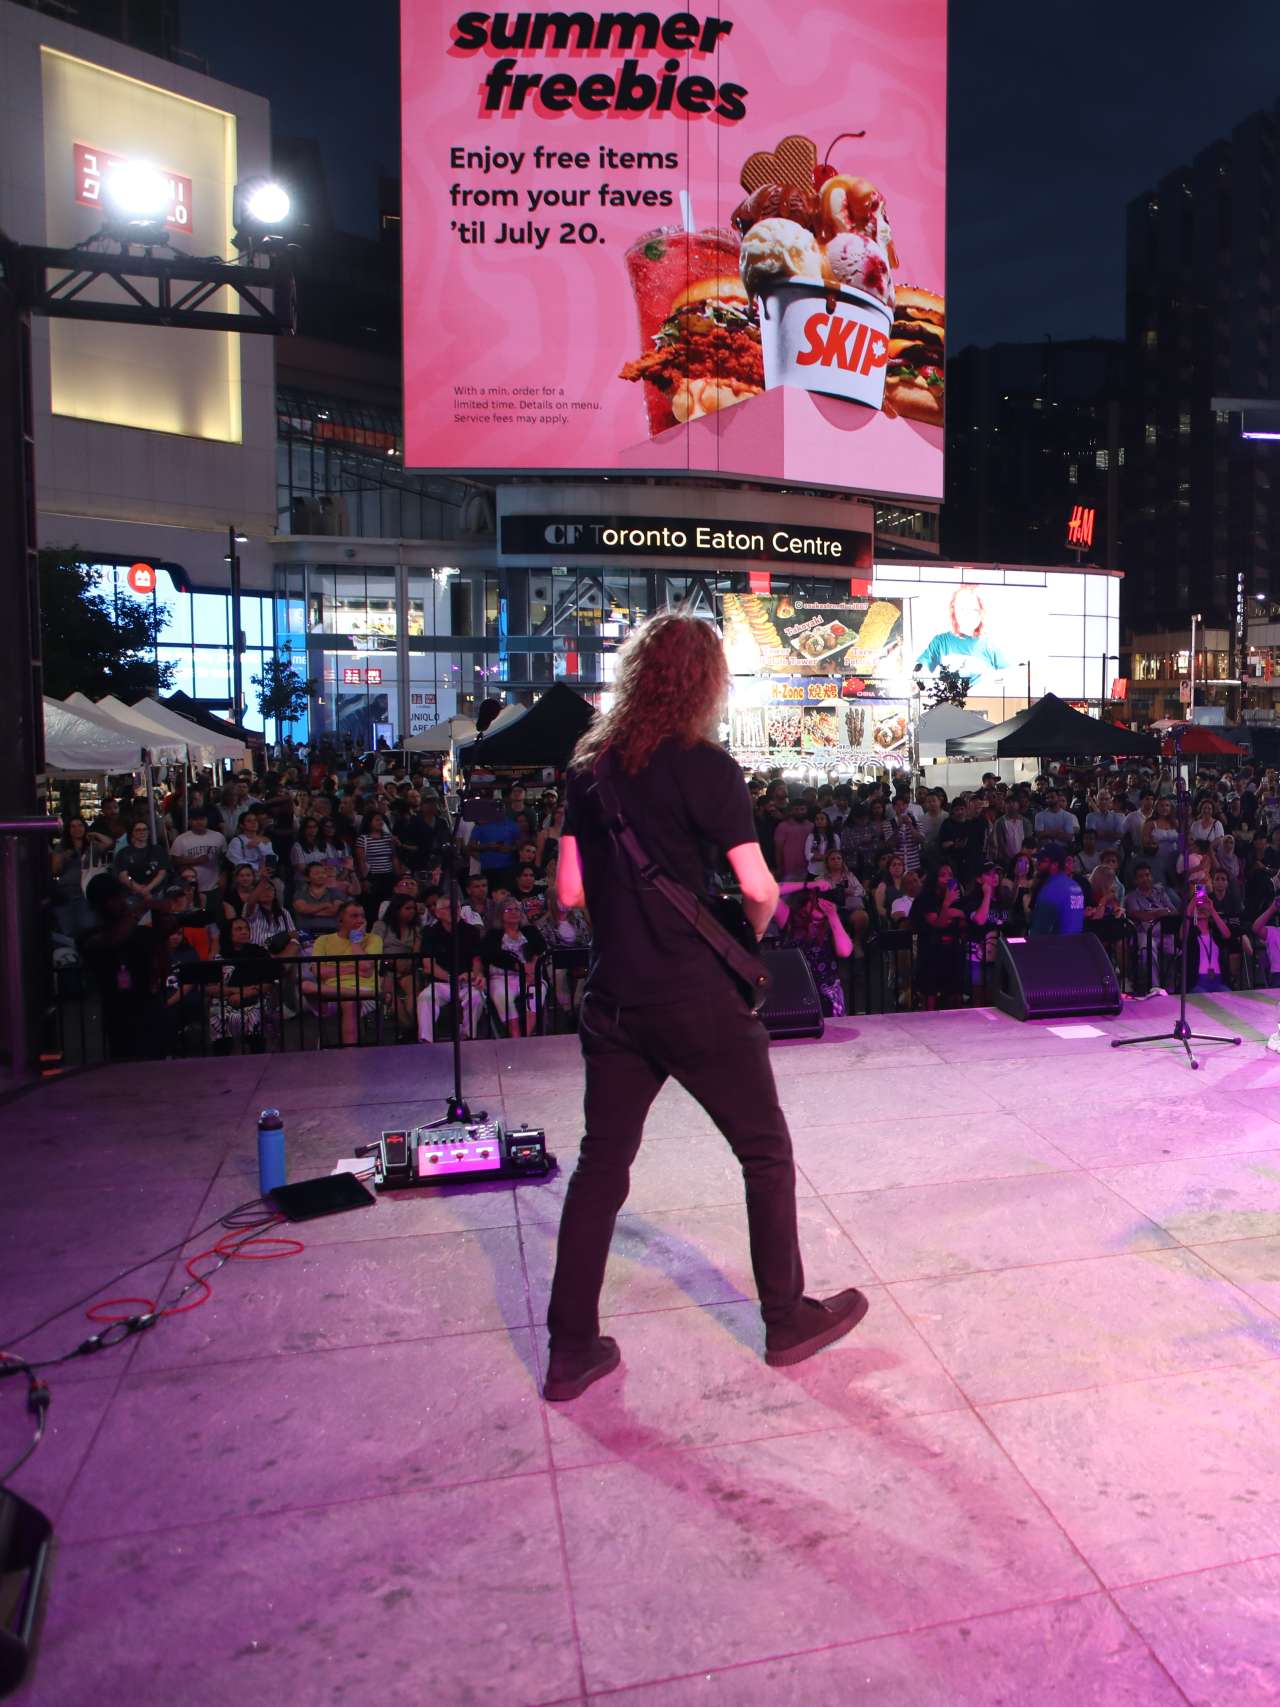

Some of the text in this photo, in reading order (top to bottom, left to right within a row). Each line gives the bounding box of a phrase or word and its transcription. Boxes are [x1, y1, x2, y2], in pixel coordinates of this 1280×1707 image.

[453, 9, 733, 54] summer
[485, 58, 748, 121] freebies
[450, 146, 679, 174] Enjoy free items
[450, 183, 673, 212] from your faves
[494, 221, 550, 249] July
[559, 222, 606, 244] 20.
[796, 312, 890, 377] SKIP
[454, 386, 477, 396] With
[488, 387, 509, 396] min.
[512, 386, 540, 396] order
[542, 386, 556, 396] for
[454, 400, 602, 410] limited time. Details on menu.
[454, 414, 569, 425] Service fees may apply.
[591, 524, 687, 548] Toronto
[696, 527, 765, 551] Eaton
[773, 532, 843, 557] Centre
